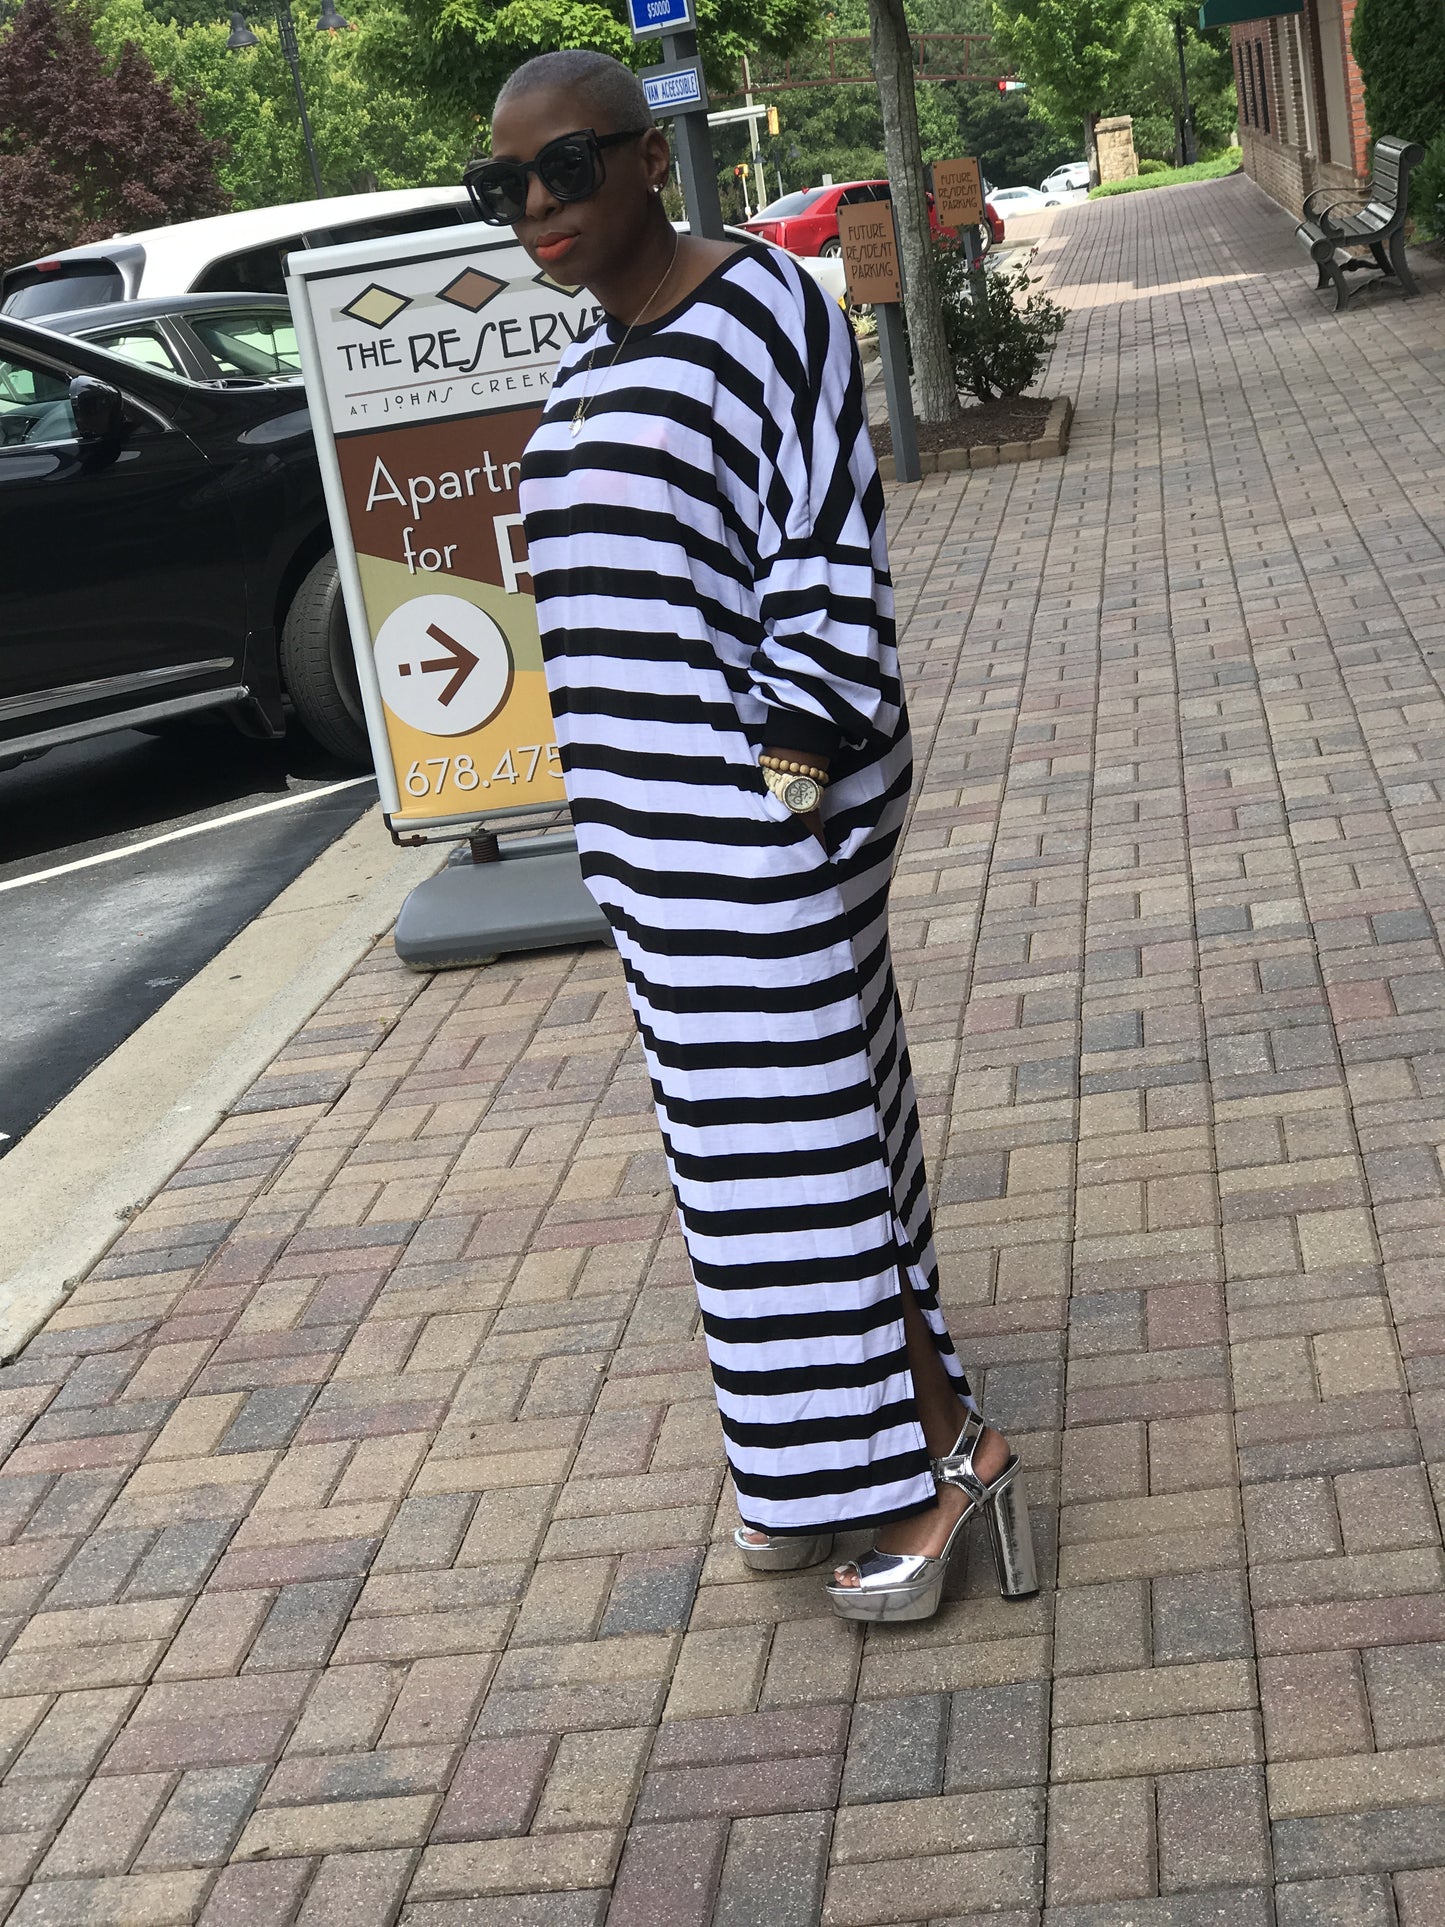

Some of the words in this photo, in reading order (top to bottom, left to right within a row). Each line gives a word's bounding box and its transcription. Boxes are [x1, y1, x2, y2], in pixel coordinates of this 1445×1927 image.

[647, 84, 659, 101] VAN
[661, 76, 696, 99] ACCESSIBLE
[941, 172, 973, 186] FUTURE
[938, 184, 978, 199] RESIDENT
[942, 198, 978, 211] PARKING
[848, 223, 887, 241] FUTURE
[846, 242, 893, 262] RESIDENT
[851, 262, 893, 279] PARKING
[337, 338, 402, 371] THE
[350, 404, 369, 416] AT
[383, 386, 454, 413] JOHNS
[471, 372, 550, 395] CREEK
[402, 527, 458, 575] for
[405, 743, 565, 797] 678.475
